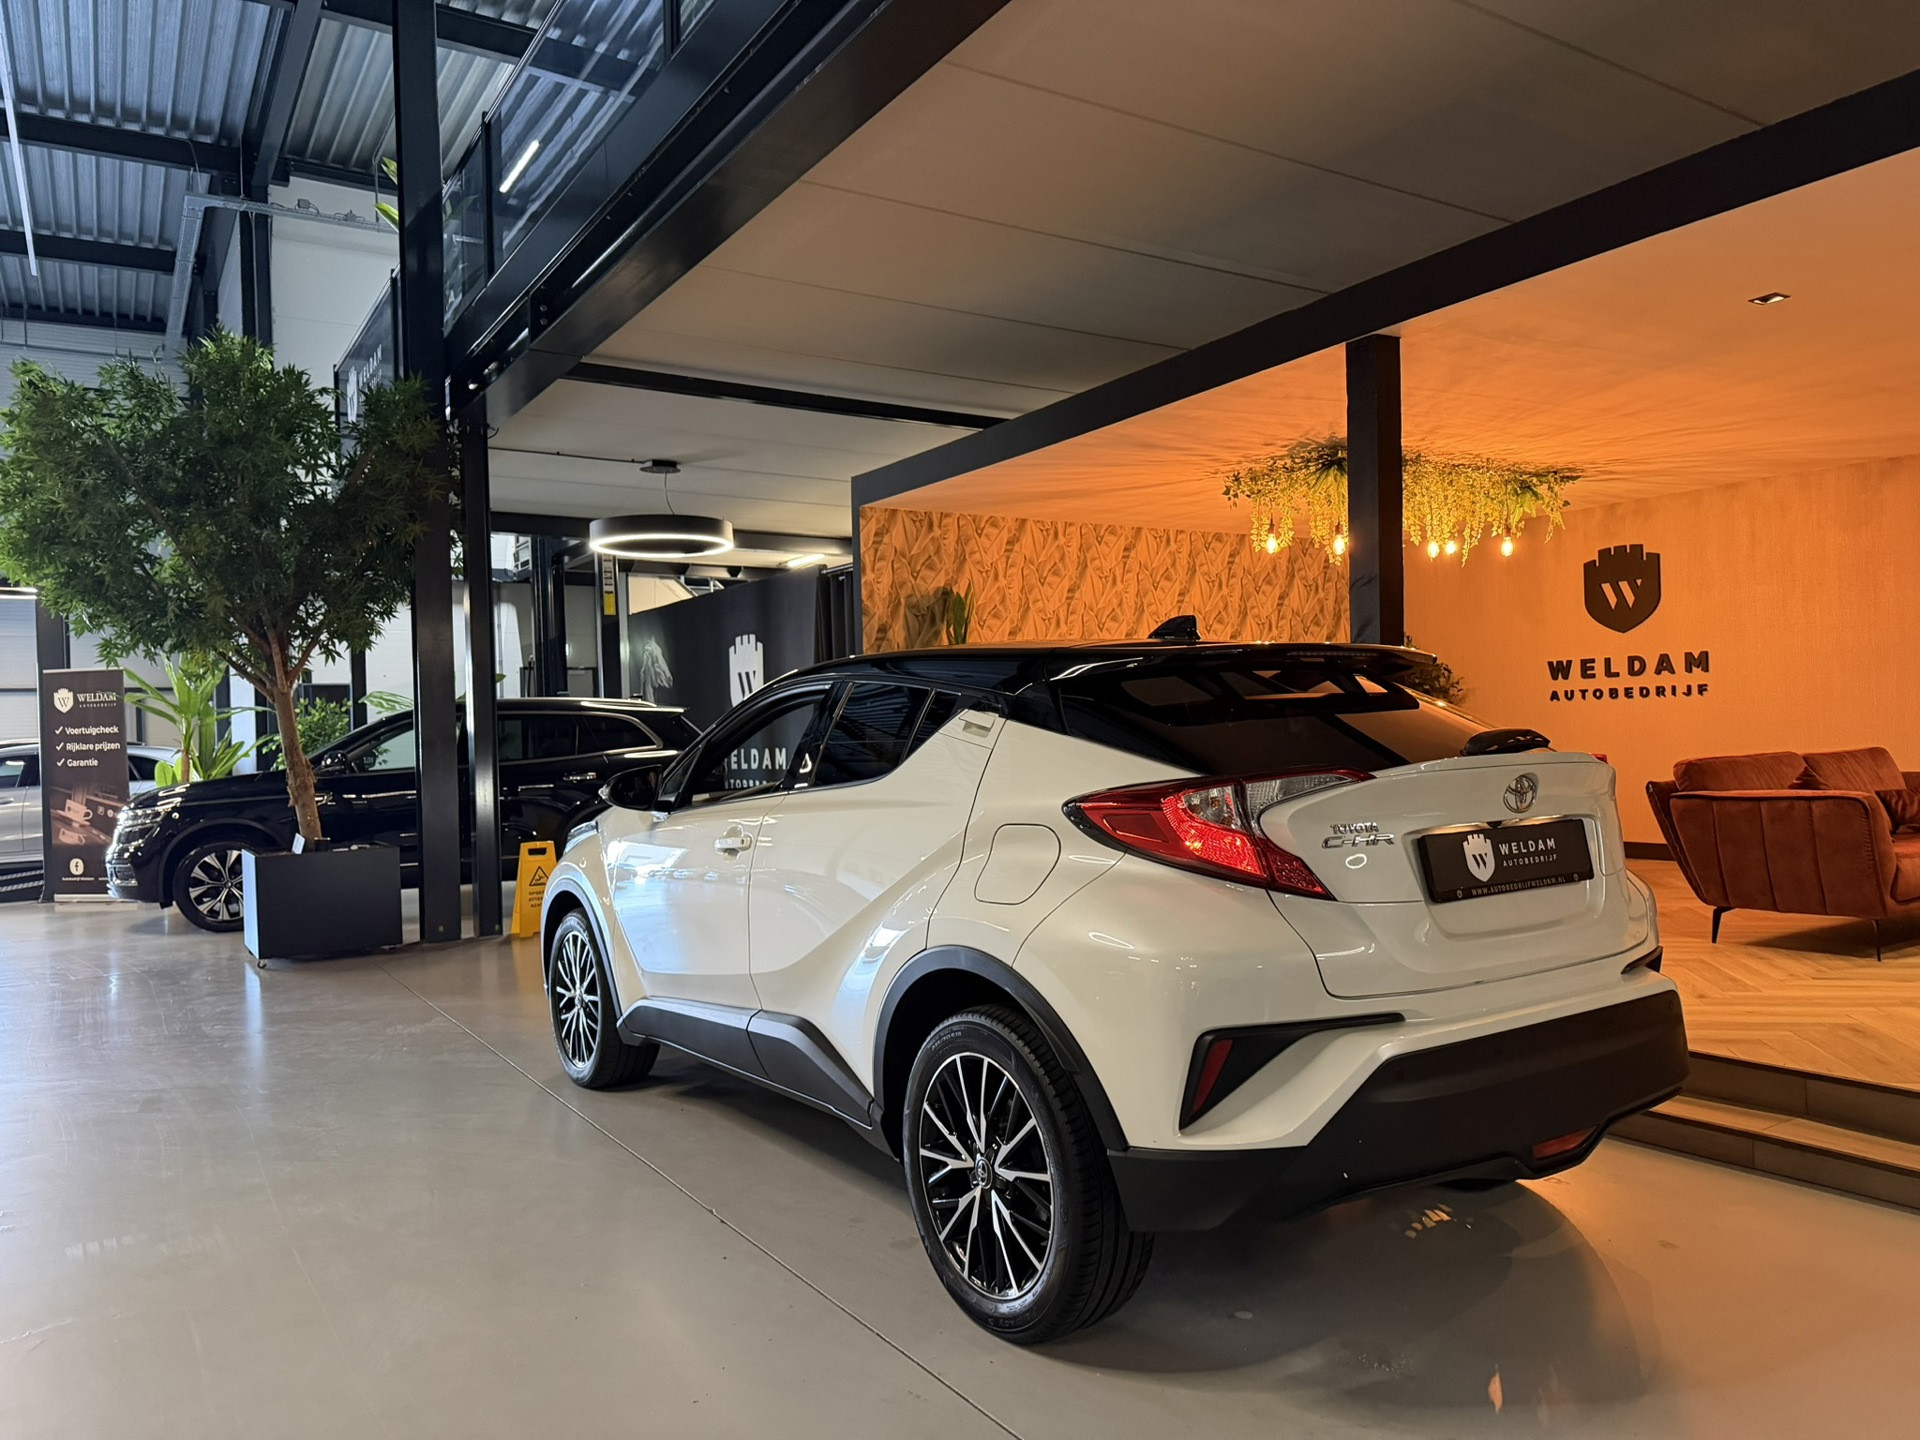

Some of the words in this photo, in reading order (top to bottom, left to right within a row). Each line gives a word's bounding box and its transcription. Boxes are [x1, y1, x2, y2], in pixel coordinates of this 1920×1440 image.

[1547, 650, 1709, 681] WELDAM
[1550, 683, 1709, 702] AUTOBEDRIJF
[65, 725, 119, 736] Voertuigcheck
[66, 742, 94, 752] Rijklare
[95, 741, 121, 751] prijzen
[67, 758, 98, 767] Garantie
[724, 747, 787, 773] ELDAM
[1330, 822, 1379, 834] TOYOTA
[1321, 833, 1395, 849] C-HR
[1498, 838, 1556, 856] WELDAM
[1503, 854, 1557, 867] AUTOBEDRIJF
